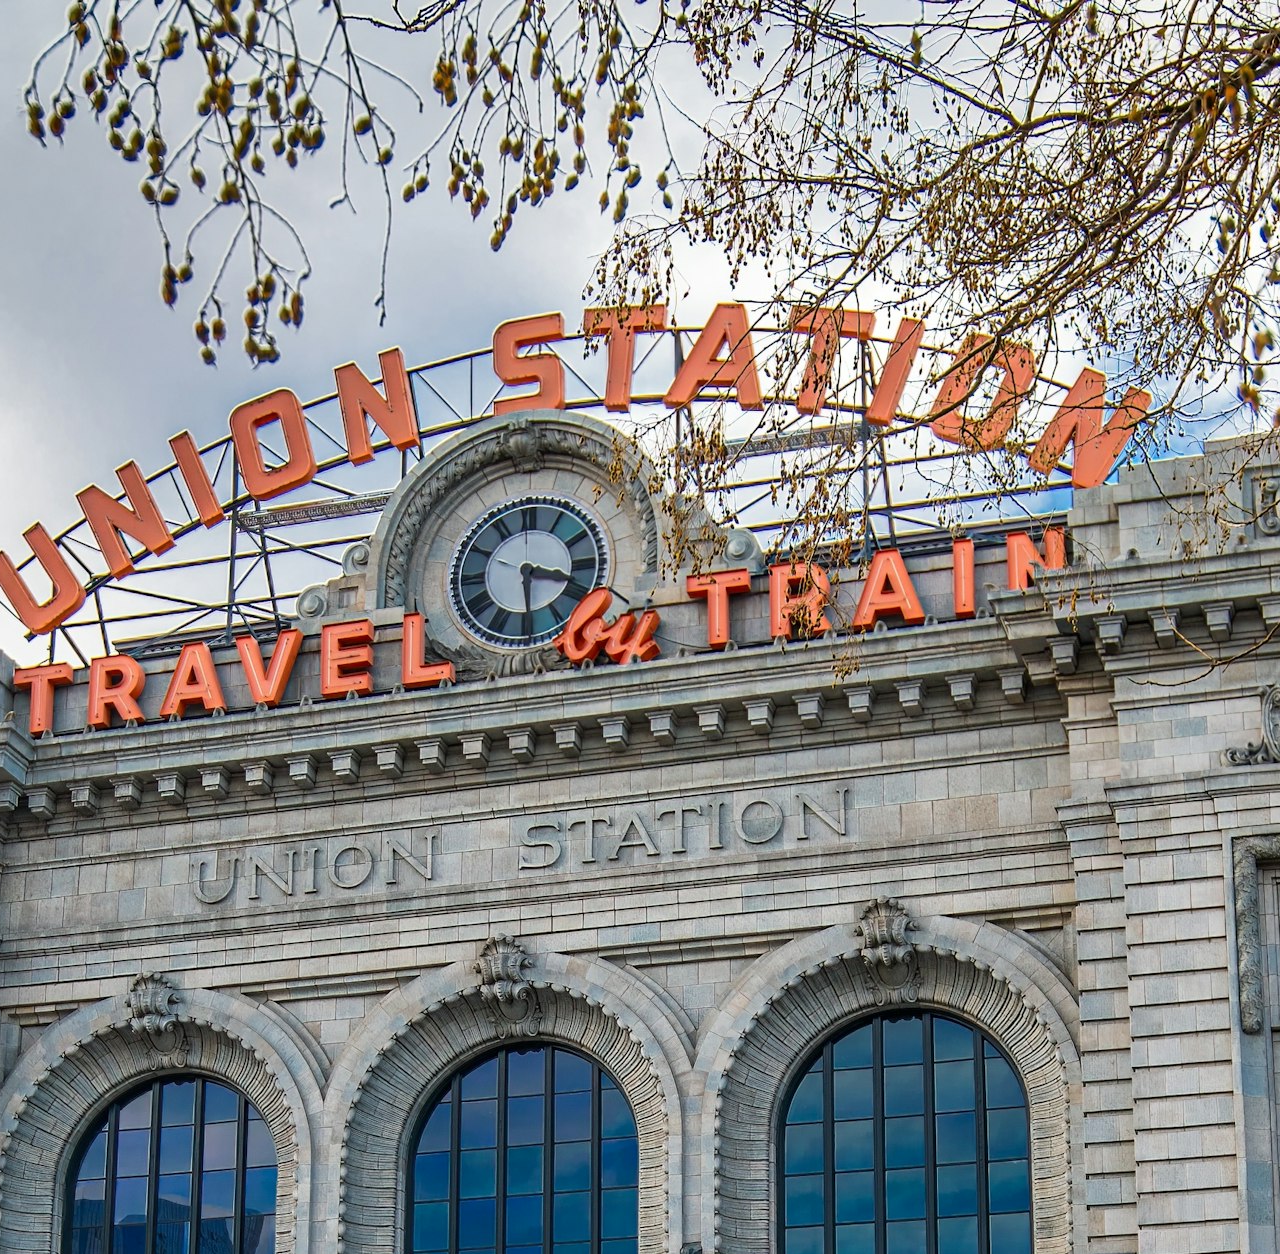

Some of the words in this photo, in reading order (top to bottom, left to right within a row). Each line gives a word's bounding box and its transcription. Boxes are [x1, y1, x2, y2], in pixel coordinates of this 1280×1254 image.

[493, 303, 1153, 488] STATION
[13, 612, 456, 738] TRAVEL
[553, 586, 661, 665] by
[686, 526, 1067, 650] TRAIN
[191, 827, 440, 903] UNION
[519, 787, 850, 870] STATION
